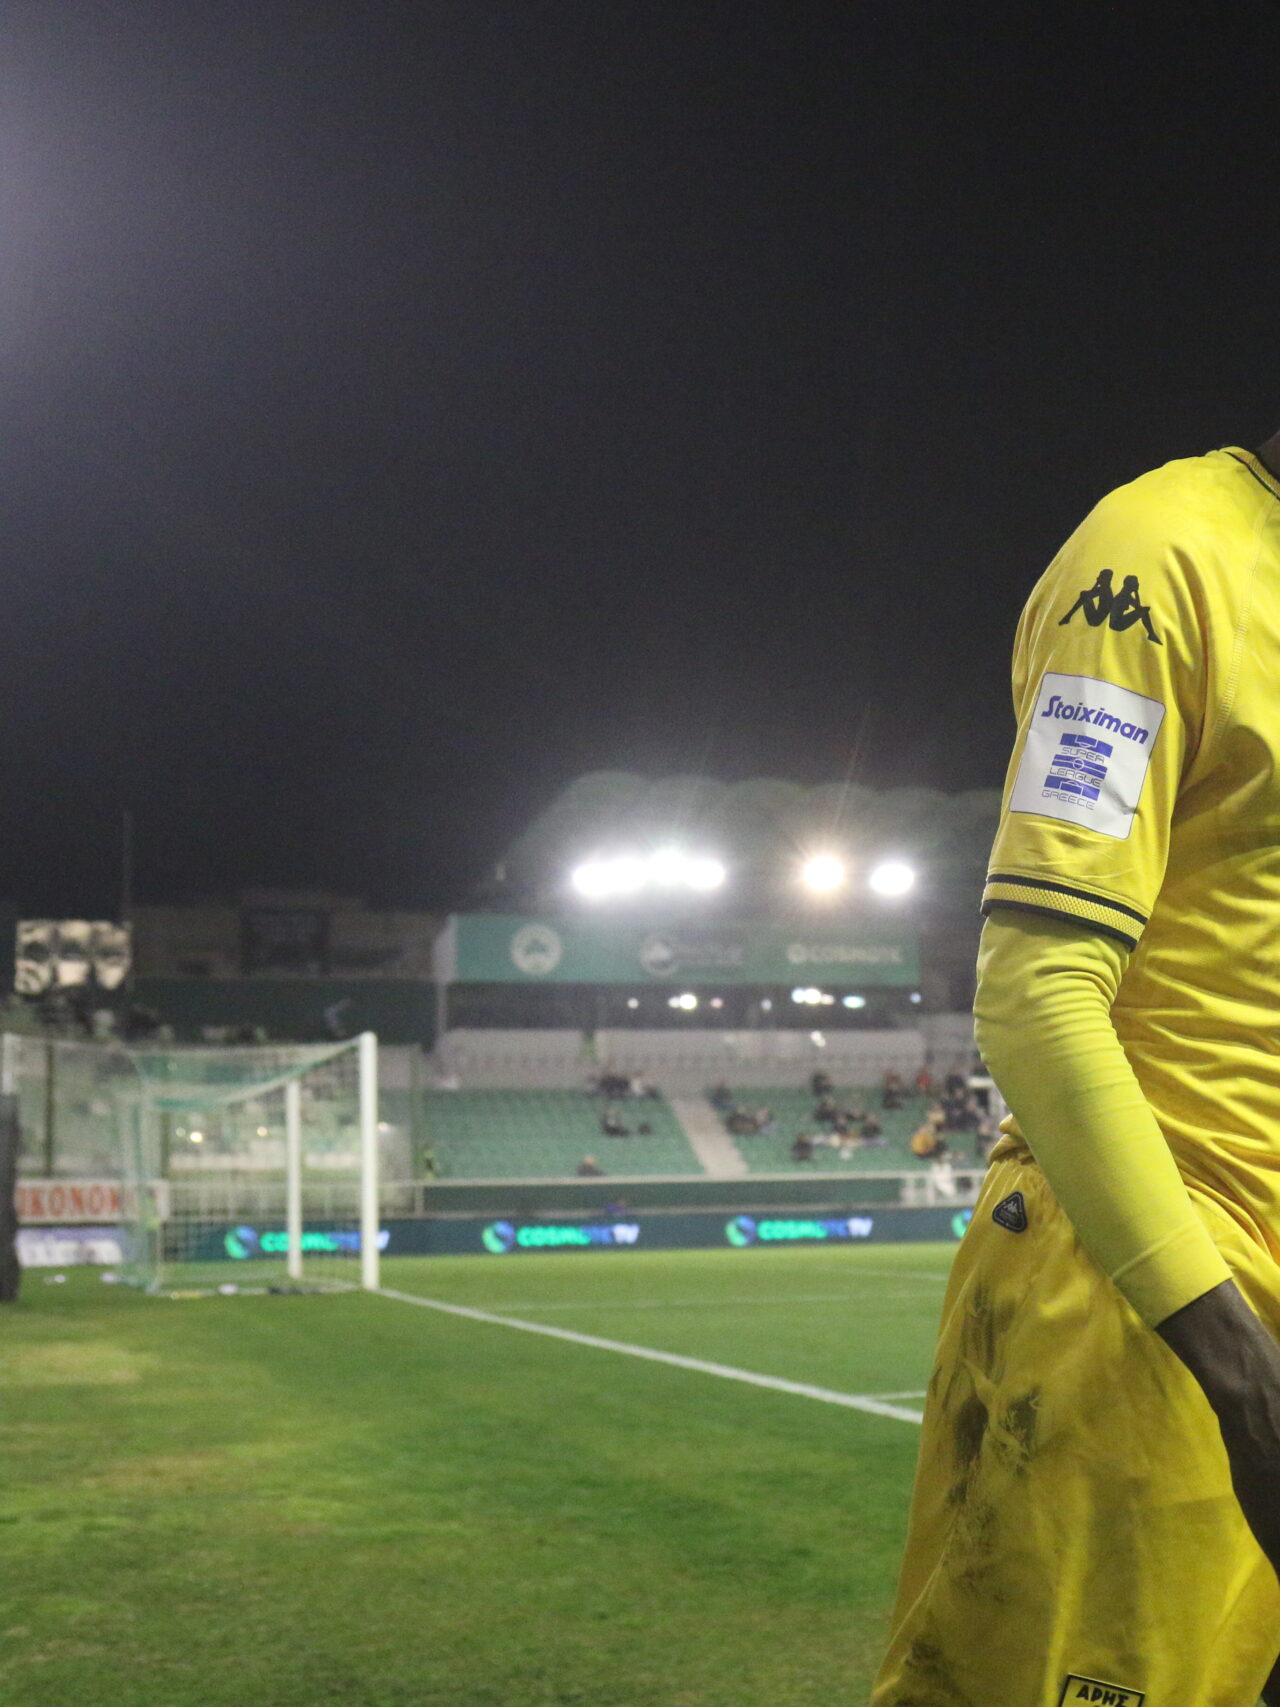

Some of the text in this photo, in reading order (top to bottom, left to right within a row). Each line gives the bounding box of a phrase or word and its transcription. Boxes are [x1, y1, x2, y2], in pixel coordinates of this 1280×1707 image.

[1041, 695, 1149, 745] Stoiximan
[1061, 747, 1105, 764] SUPER
[1049, 767, 1103, 786] LEAGUE
[1041, 789, 1096, 811] GREECE
